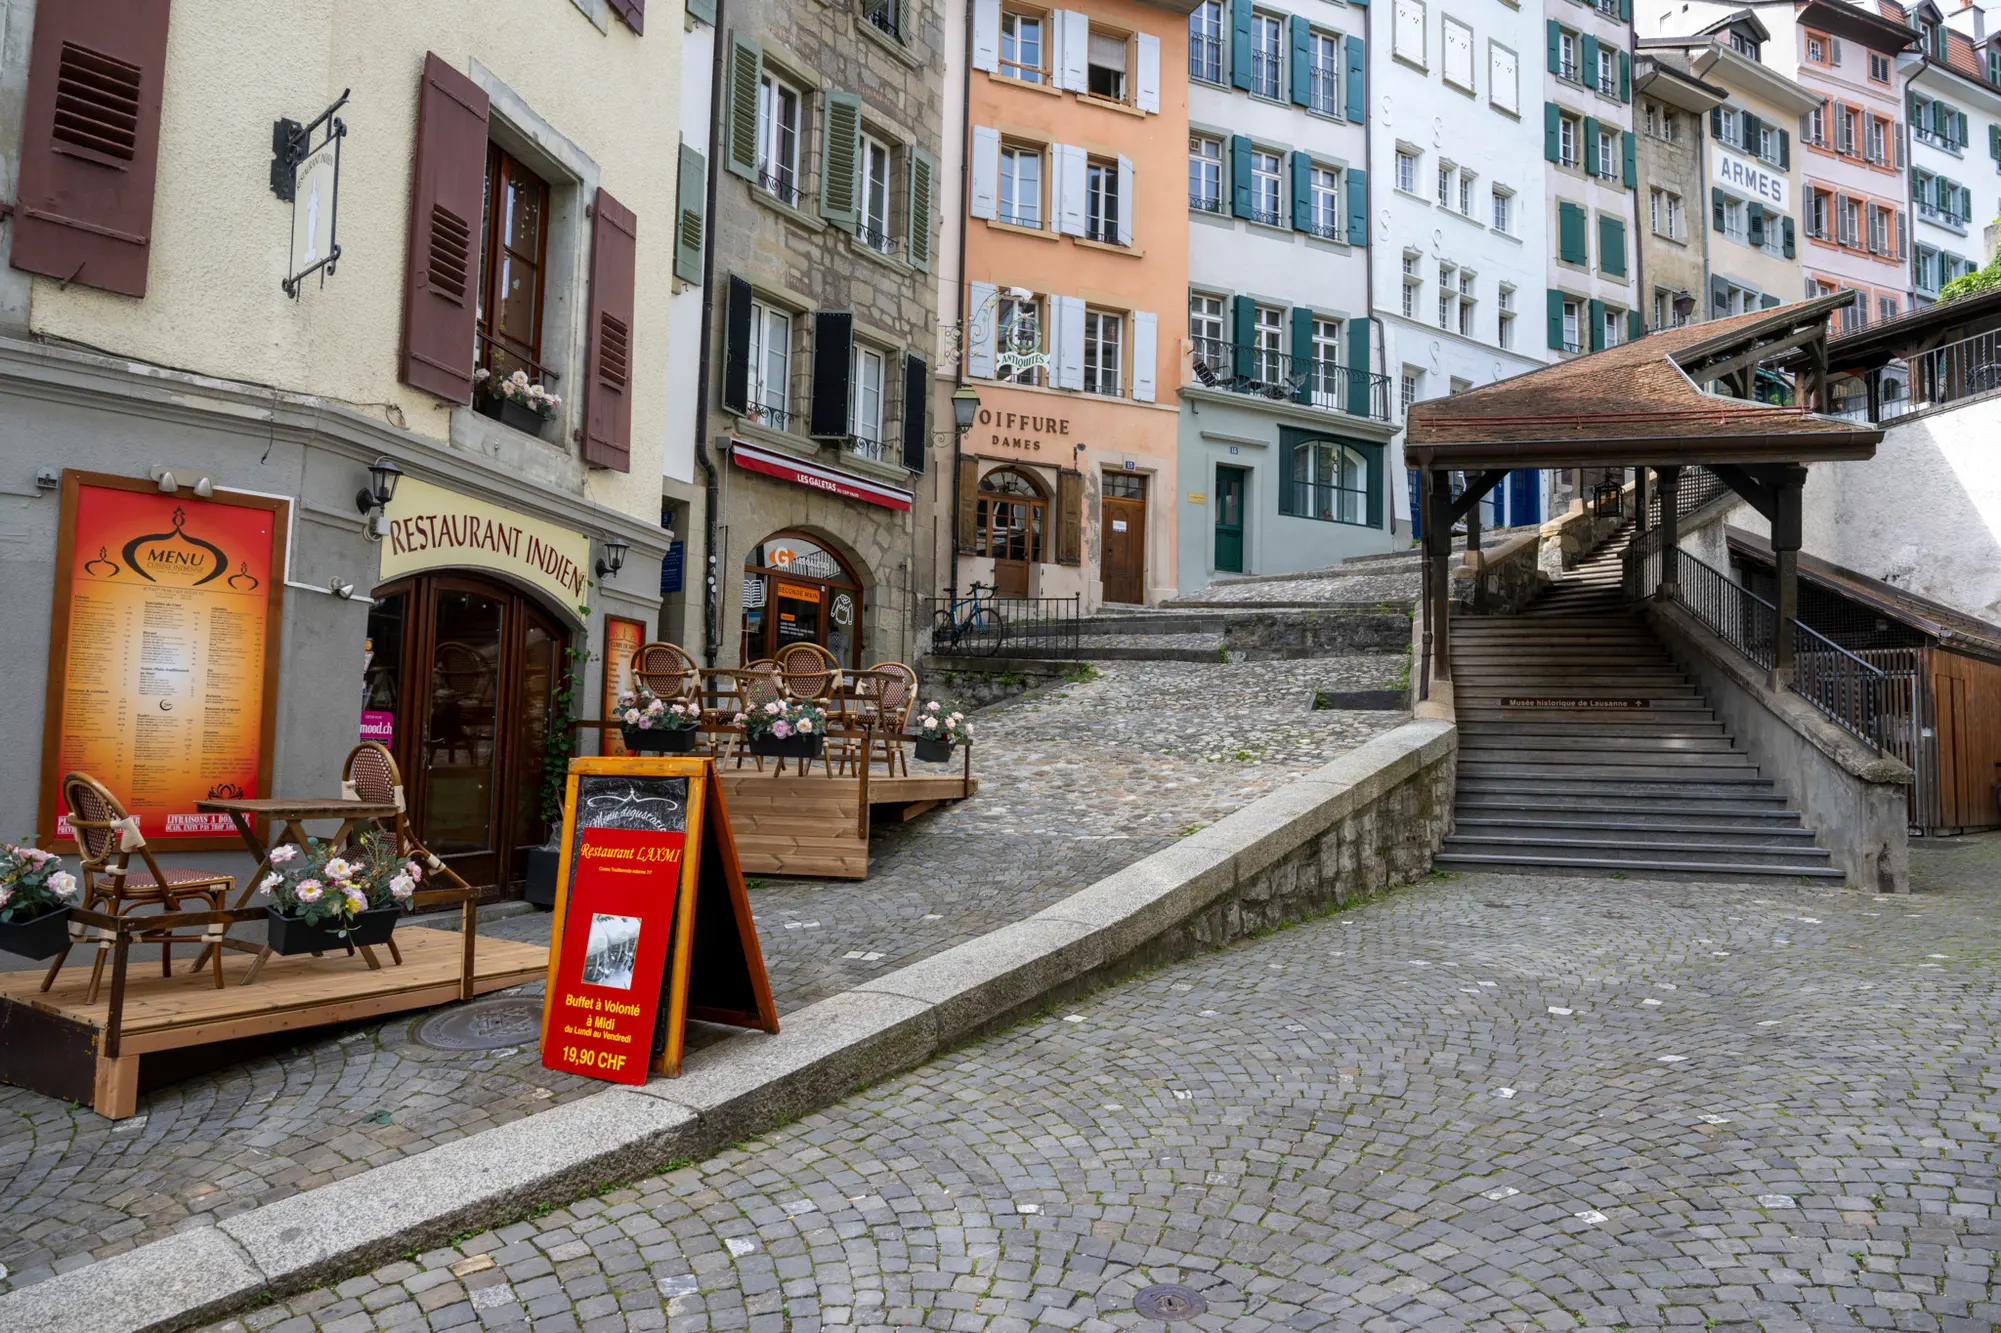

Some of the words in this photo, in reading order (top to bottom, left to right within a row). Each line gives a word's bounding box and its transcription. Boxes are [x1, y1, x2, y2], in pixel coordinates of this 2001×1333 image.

[1721, 156, 1782, 202] ARMES
[979, 409, 1070, 435] OIFFURE
[992, 435, 1041, 451] DAMES
[797, 473, 809, 484] LES
[809, 476, 837, 491] GALETAS
[147, 548, 205, 566] MENU
[389, 514, 523, 558] RESTAURANT
[525, 534, 585, 598] INDIEN
[777, 586, 805, 597] SECONDE
[804, 590, 819, 599] MAIN
[1536, 699, 1576, 708] historique
[360, 721, 393, 734] mood.ch
[167, 814, 208, 824] LIVRAISONS
[589, 810, 619, 829] Menu
[620, 806, 667, 832] dégustatio
[581, 843, 635, 859] Restaurant
[636, 846, 681, 863] LAXMI
[565, 994, 594, 1009] Buffet
[595, 998, 602, 1011] à
[604, 1000, 640, 1017] Volonté
[586, 1014, 592, 1027] à
[594, 1016, 615, 1030] Midi
[564, 1025, 573, 1033] du
[573, 1026, 592, 1037] Lundi
[603, 1031, 632, 1043] Vendredi
[563, 1045, 595, 1066] 19,90
[597, 1052, 627, 1071] CHF
